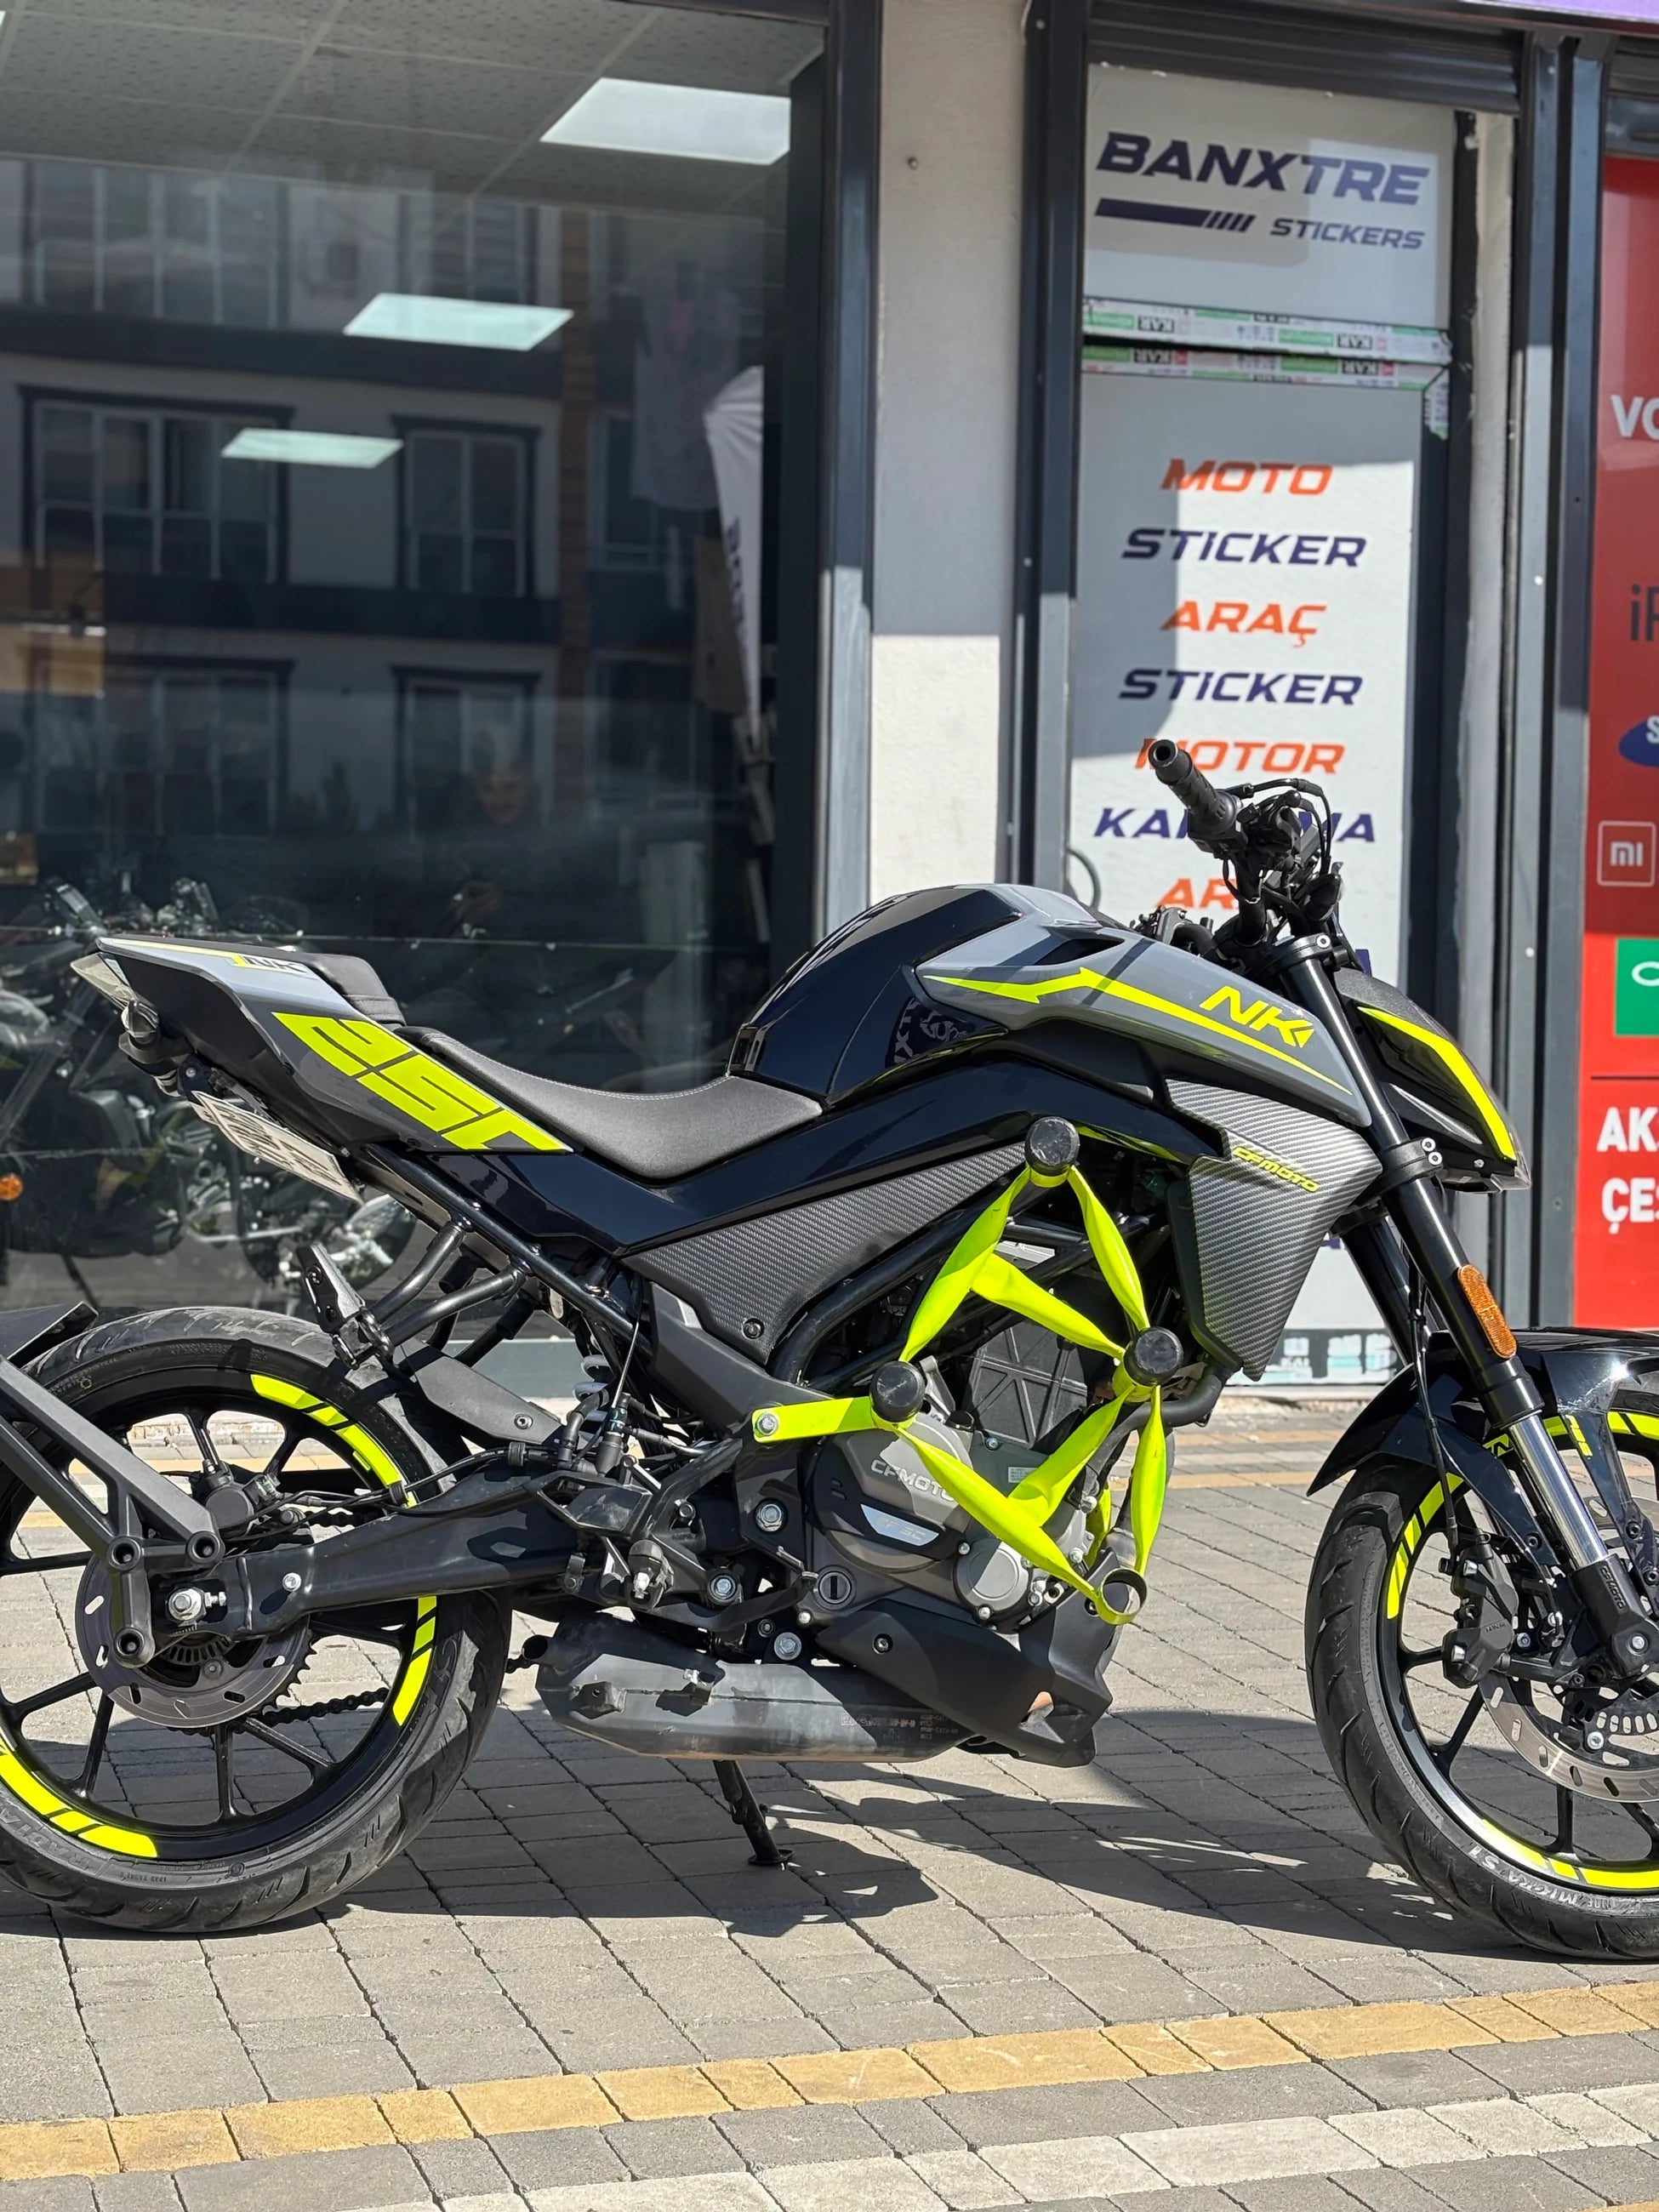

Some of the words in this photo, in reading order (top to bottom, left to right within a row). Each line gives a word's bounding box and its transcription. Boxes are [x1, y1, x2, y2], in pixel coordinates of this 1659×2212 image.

[1096, 130, 1430, 205] BANXTRE
[1270, 218, 1425, 250] STICKERS
[1160, 458, 1333, 496] MOTO
[1121, 527, 1366, 567] STICKER
[1160, 601, 1326, 647] ARAÇ
[1119, 669, 1363, 705] STICKER
[1199, 985, 1315, 1048] NK
[1596, 1105, 1659, 1153] AK
[1231, 1146, 1321, 1193] CFMOTO
[1600, 1176, 1659, 1235] ÇE
[1599, 1565, 1625, 1611] CFMOTO
